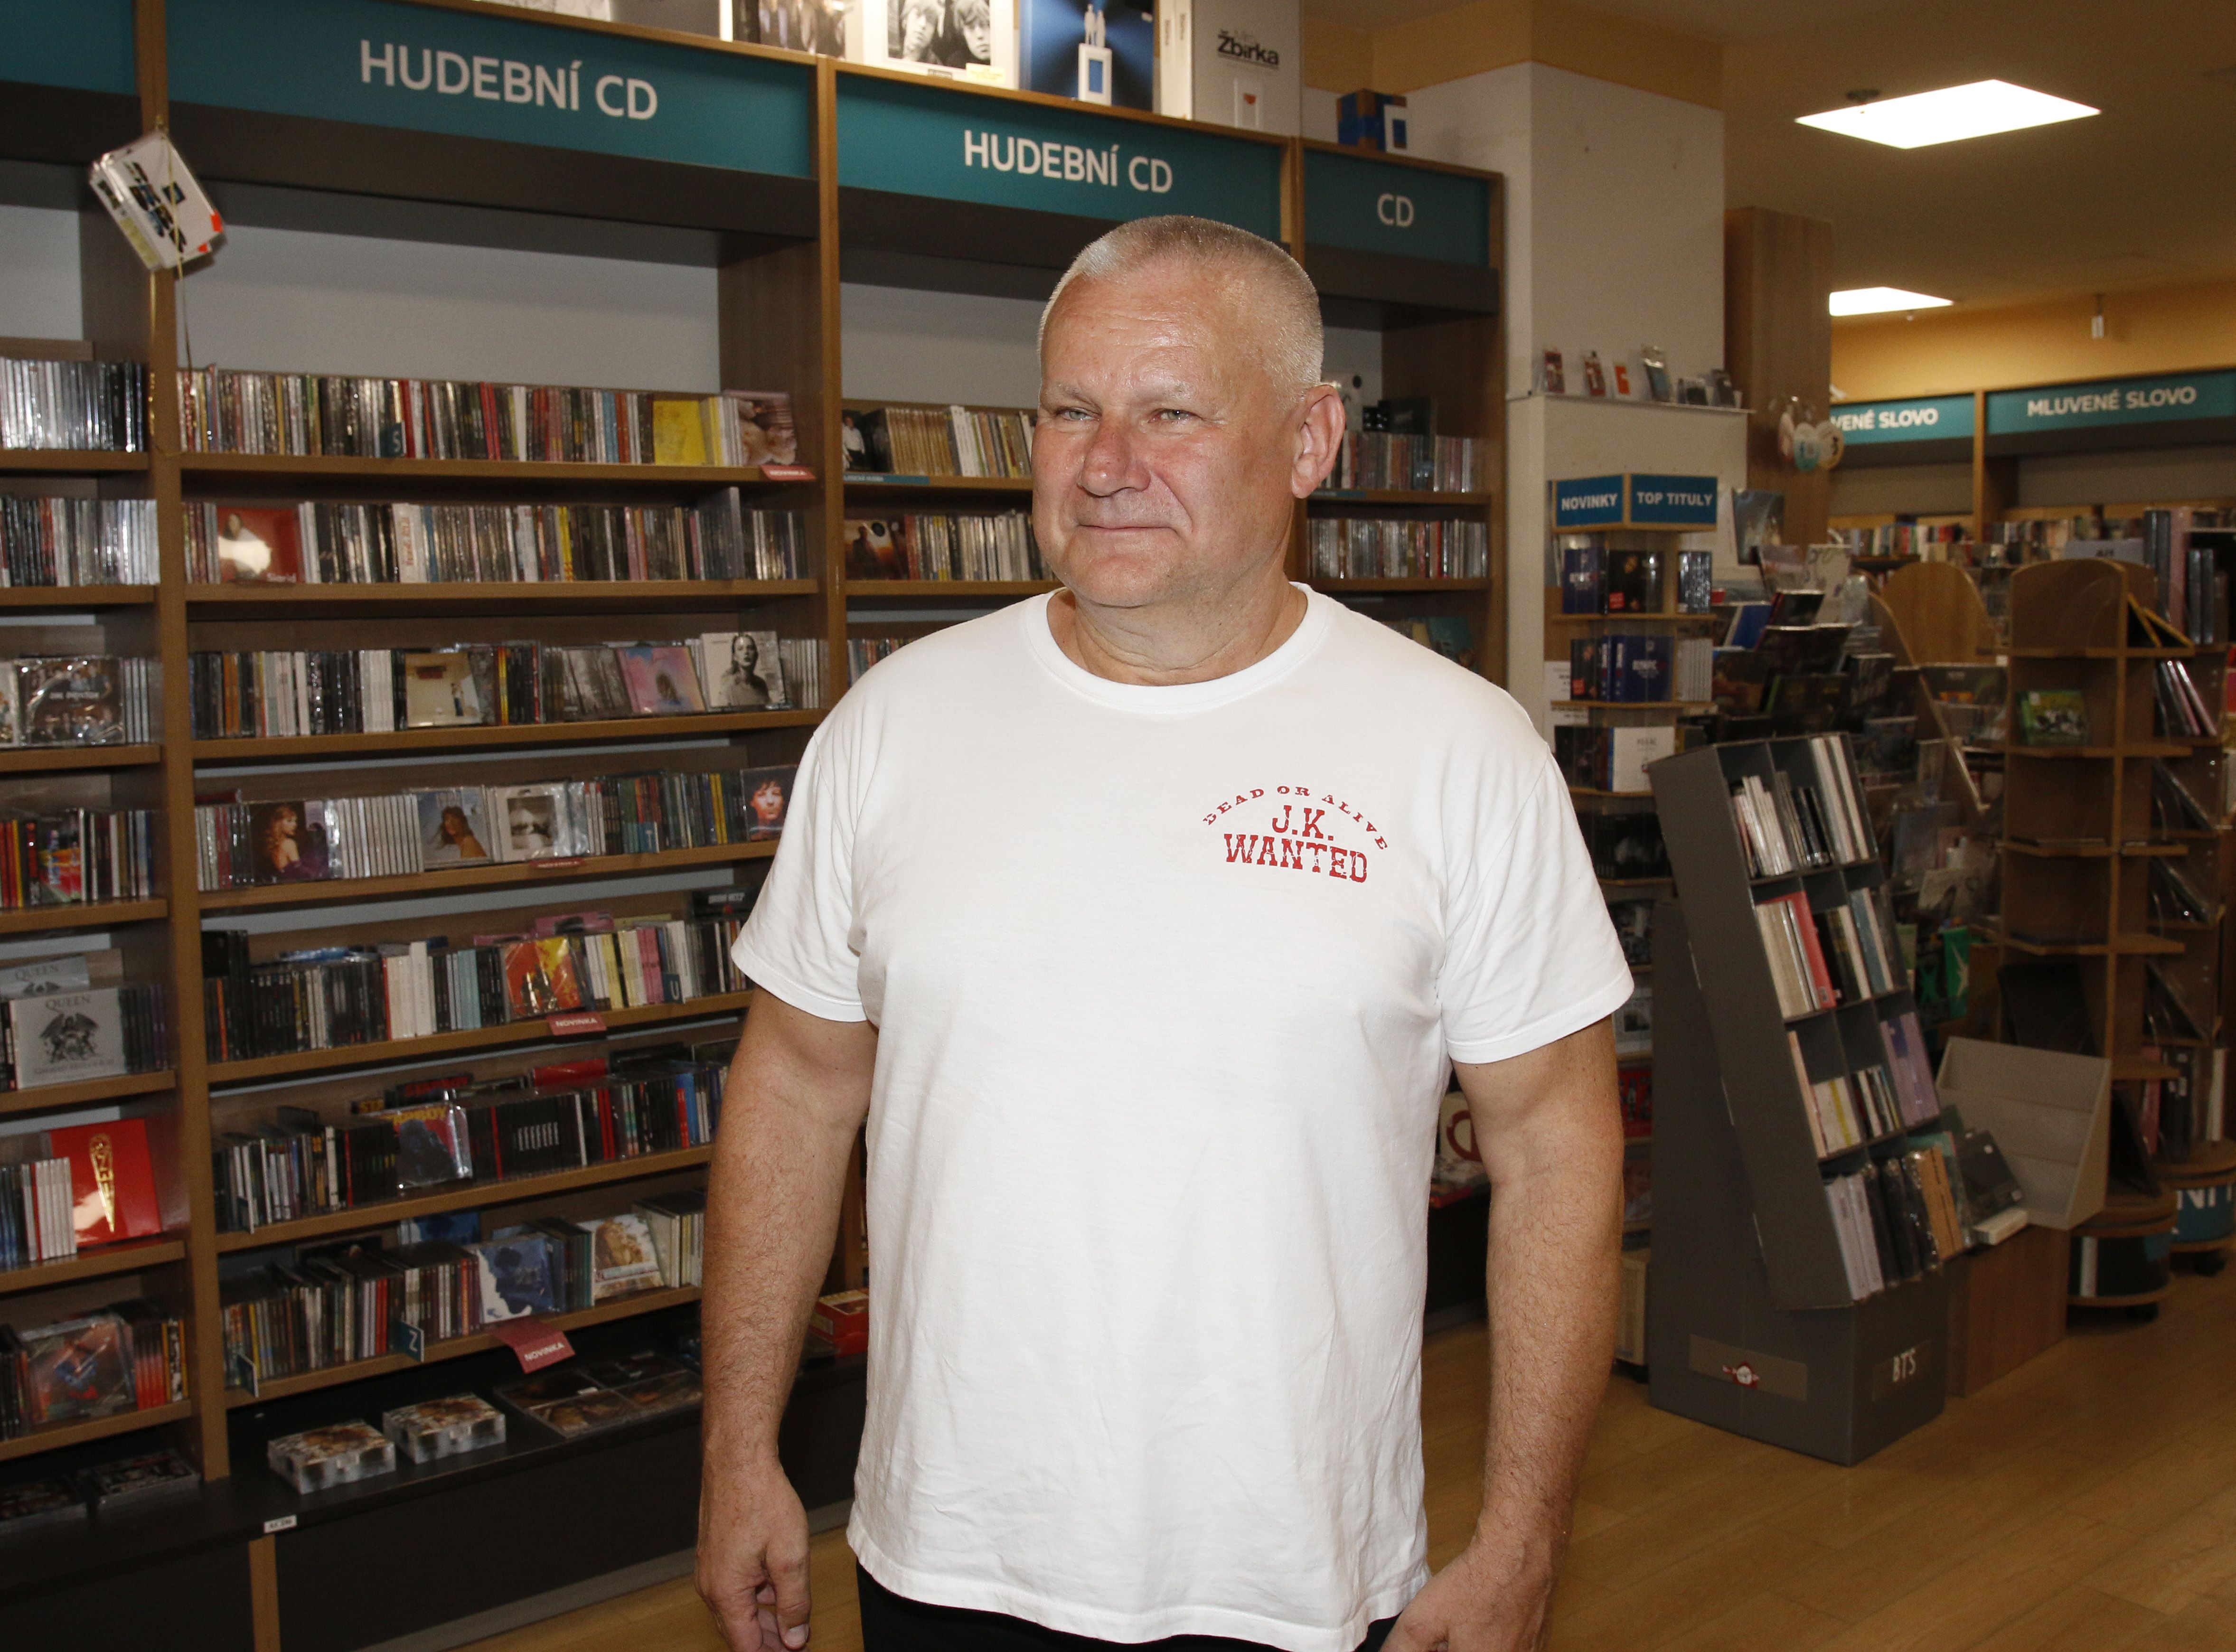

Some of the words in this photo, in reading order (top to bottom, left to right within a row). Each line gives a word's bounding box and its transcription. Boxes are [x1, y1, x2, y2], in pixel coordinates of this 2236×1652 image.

[1218, 29, 1279, 65] Žbirka
[360, 39, 582, 111] HUDEBNÍ
[595, 75, 658, 120] CD
[964, 129, 1120, 187] HUDEBNÍ
[1128, 156, 1173, 193] CD
[1377, 193, 1415, 228] CD
[2027, 387, 2120, 418] MLUVENÉ
[2126, 385, 2198, 410] SLOVO
[1879, 407, 1939, 430] SLOVO
[1561, 493, 1617, 511] NOVINKY
[1636, 491, 1663, 505] TOP
[1667, 492, 1713, 507] TITULY
[1203, 788, 1265, 826] DEAD
[1277, 786, 1311, 797] OR
[1322, 794, 1388, 850] ALIVE
[1272, 805, 1334, 841] J.K.
[1224, 833, 1368, 883] WANTED
[670, 980, 680, 1000] U
[555, 1017, 598, 1027] NOVINKA
[409, 1329, 418, 1352] Z
[524, 1341, 566, 1362] NOVINKA
